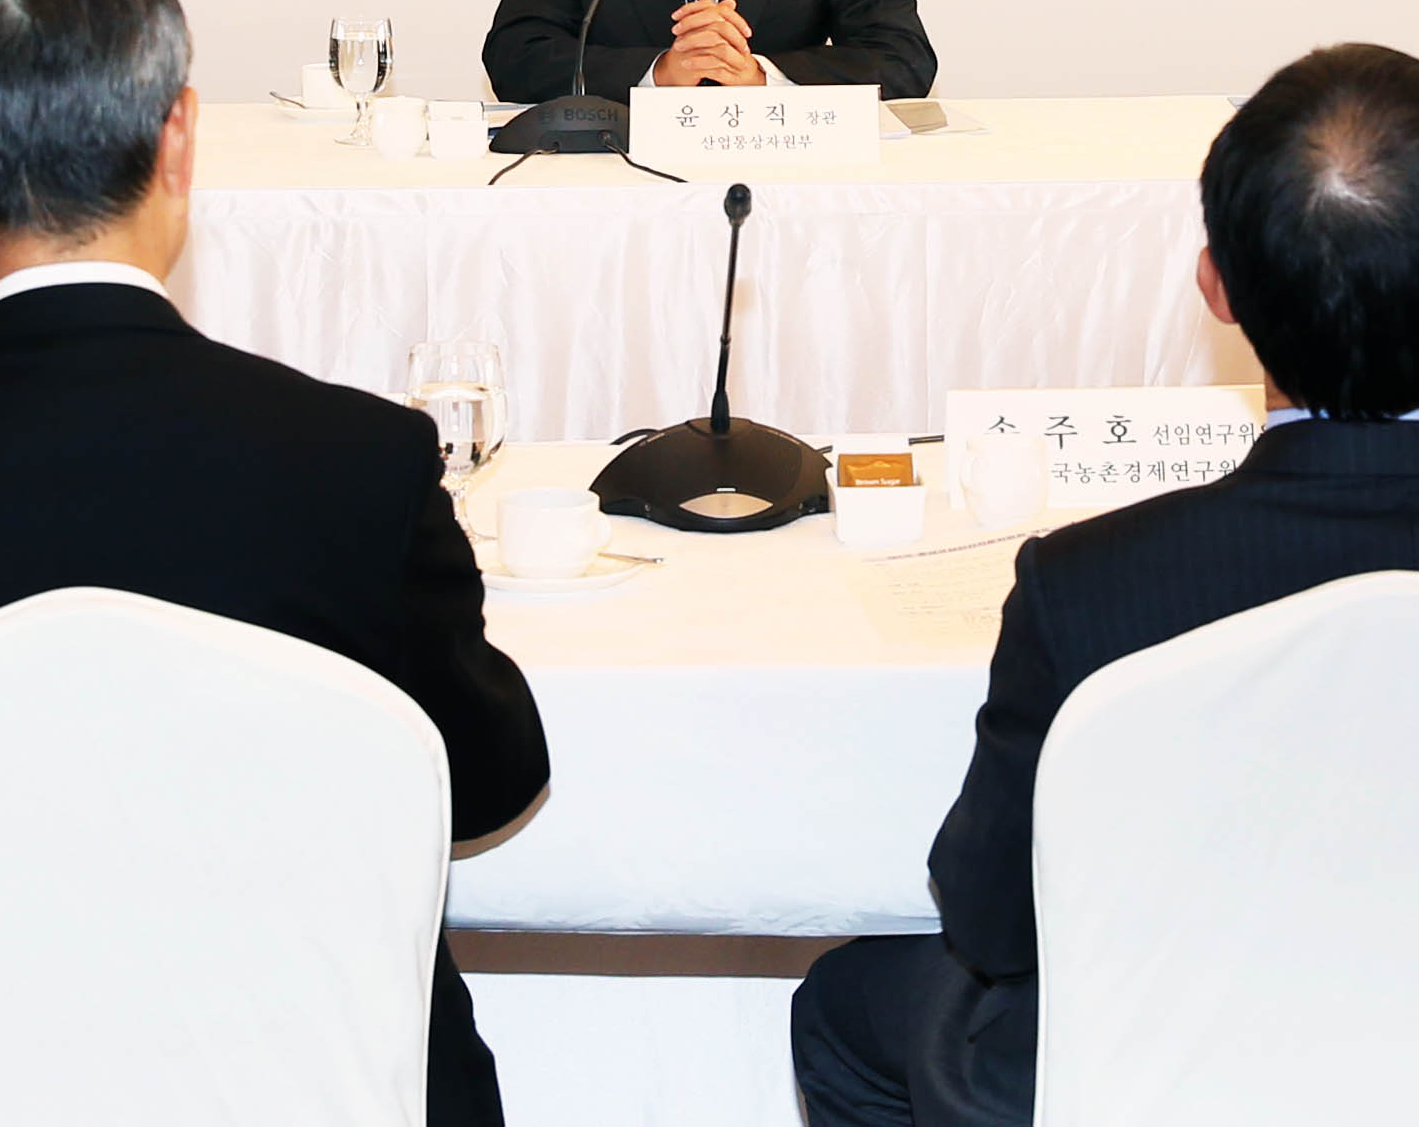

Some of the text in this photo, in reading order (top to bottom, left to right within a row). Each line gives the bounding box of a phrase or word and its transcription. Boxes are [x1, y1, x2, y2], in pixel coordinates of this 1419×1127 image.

[563, 108, 618, 122] BOSCH
[806, 110, 837, 125] 장관
[701, 134, 813, 151] 산업통상자원부
[1153, 421, 1269, 446] 선임연구위
